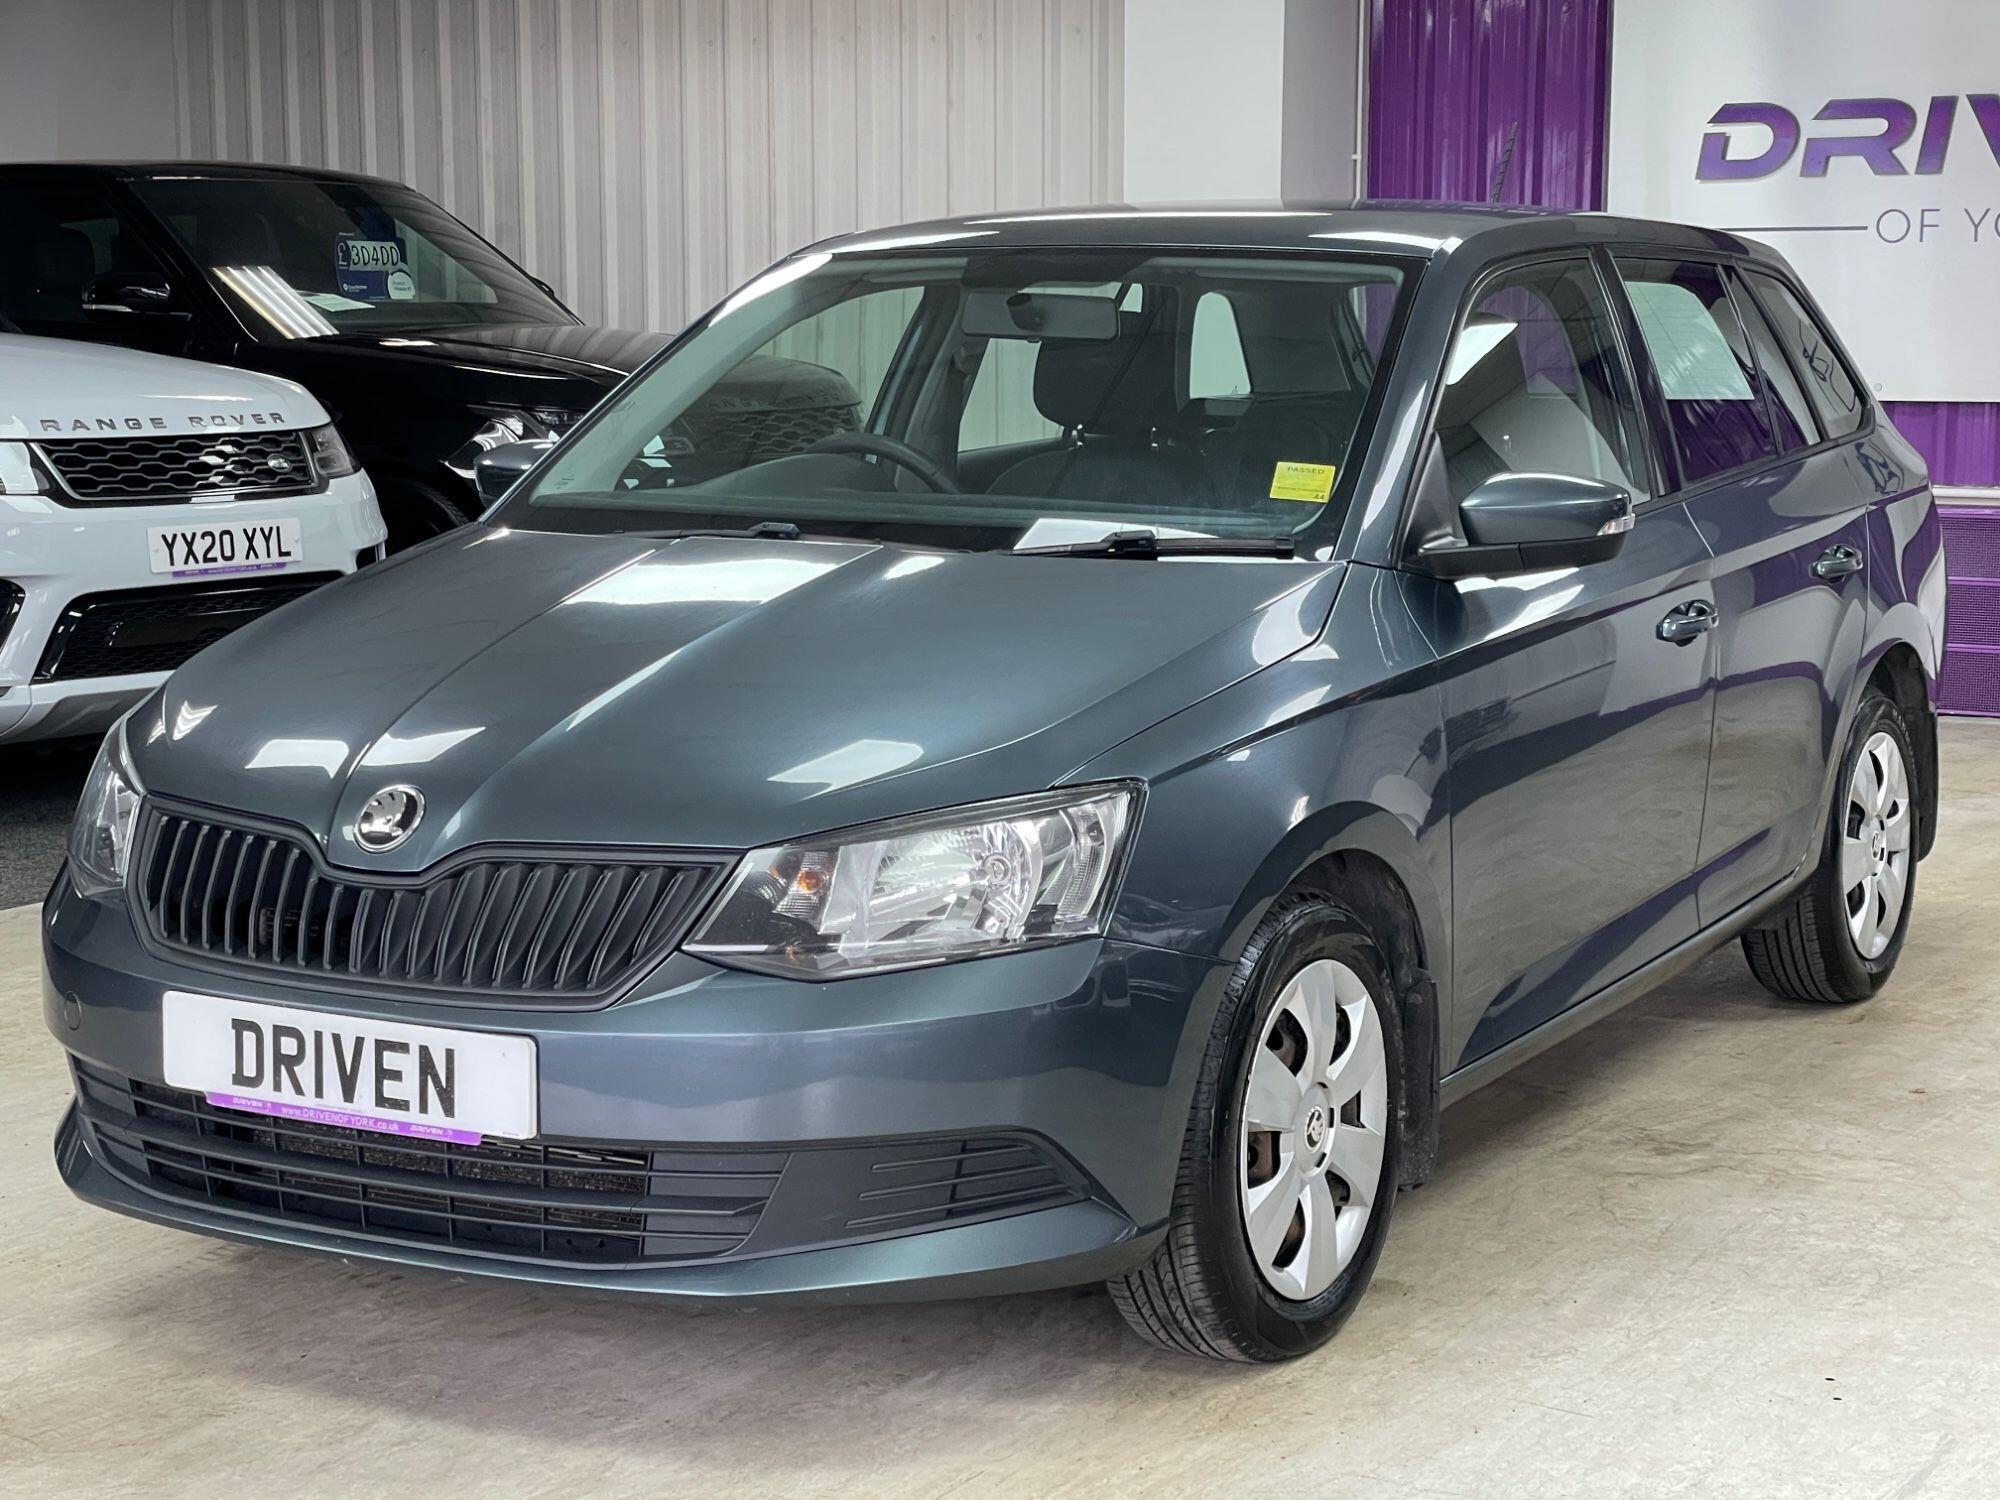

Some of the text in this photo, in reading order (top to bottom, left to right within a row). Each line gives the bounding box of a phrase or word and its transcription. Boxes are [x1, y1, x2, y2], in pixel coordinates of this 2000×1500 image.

[1876, 208, 2000, 243] OF Y
[40, 412, 285, 432] RANGE ROVER
[1287, 466, 1325, 474] PASSED
[161, 526, 291, 566] YX20 XYL
[231, 1018, 455, 1118] DRIVEN
[232, 1097, 262, 1108] DRIVEN
[410, 1124, 443, 1135] DRIVEN
